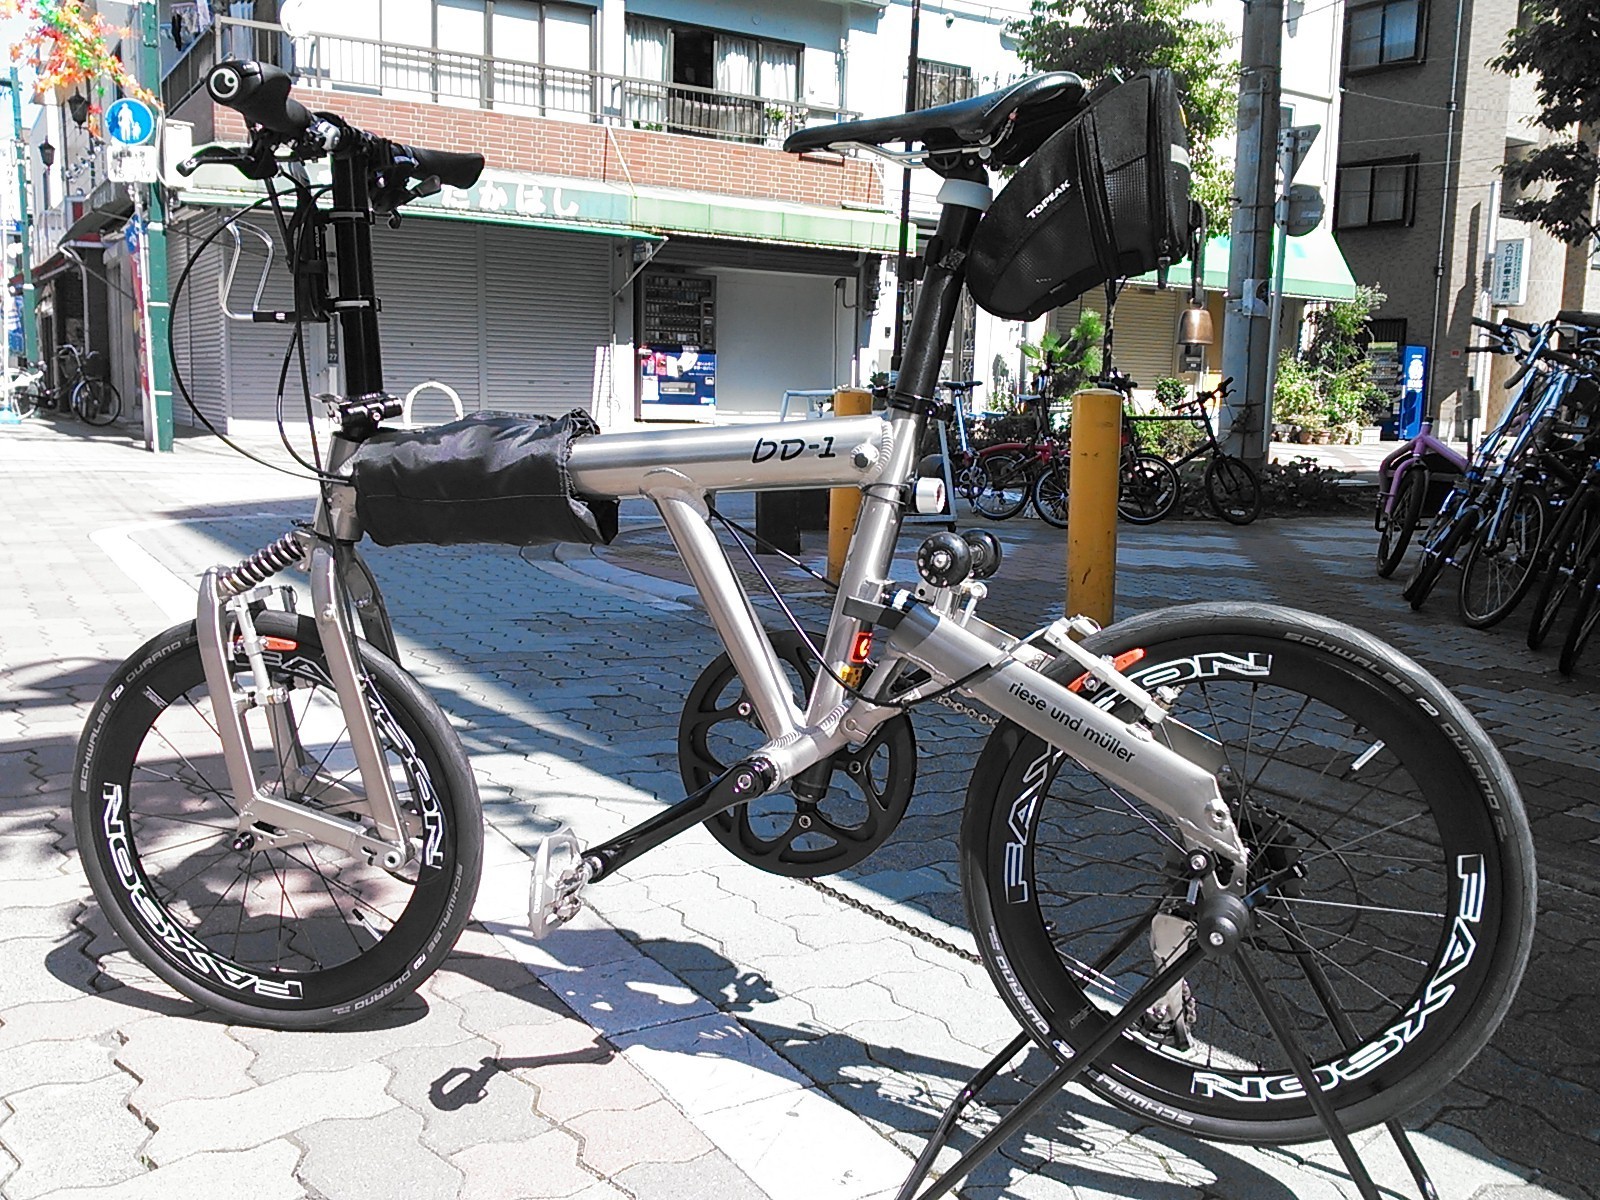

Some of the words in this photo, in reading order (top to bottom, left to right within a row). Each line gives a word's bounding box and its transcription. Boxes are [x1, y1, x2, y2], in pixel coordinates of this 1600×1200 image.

[1026, 179, 1071, 219] TOPEAK
[79, 702, 112, 793] SCHWALBE
[125, 640, 182, 683] DURANO
[1009, 681, 1048, 712] riese
[1050, 706, 1084, 733] und
[1083, 725, 1136, 764] müller
[1283, 631, 1415, 695] SCHWALBE
[1441, 722, 1501, 810] DURANO
[427, 862, 464, 953] SCHWALBE
[354, 970, 412, 1011] DURANO
[996, 955, 1051, 1036] DURANO
